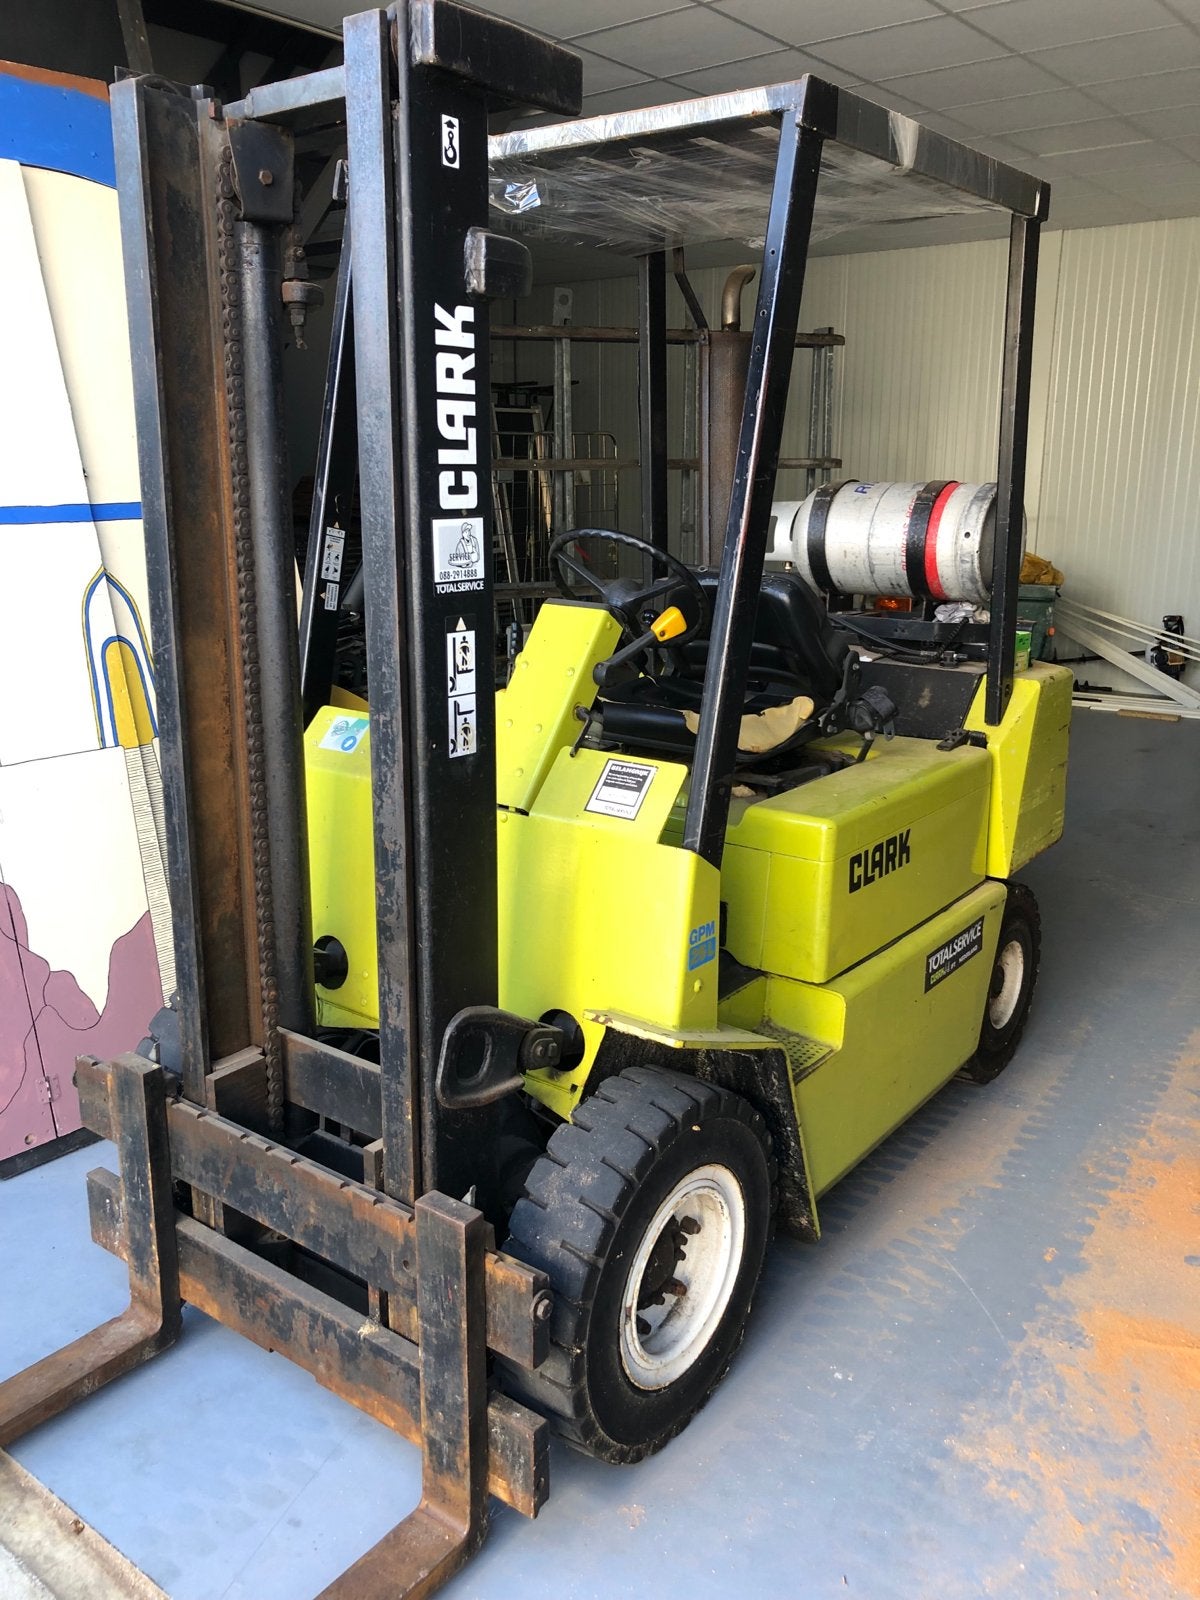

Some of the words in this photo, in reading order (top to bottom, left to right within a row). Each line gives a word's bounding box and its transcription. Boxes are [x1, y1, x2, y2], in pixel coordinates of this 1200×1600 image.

[434, 302, 477, 509] CLARK
[449, 552, 471, 562] SERVICE
[435, 580, 485, 594] TOTALSERVICE
[440, 569, 477, 580] 088-2914888
[849, 828, 911, 894] CLARK
[689, 920, 715, 945] GPM
[928, 920, 982, 973] TOTALSERVICE
